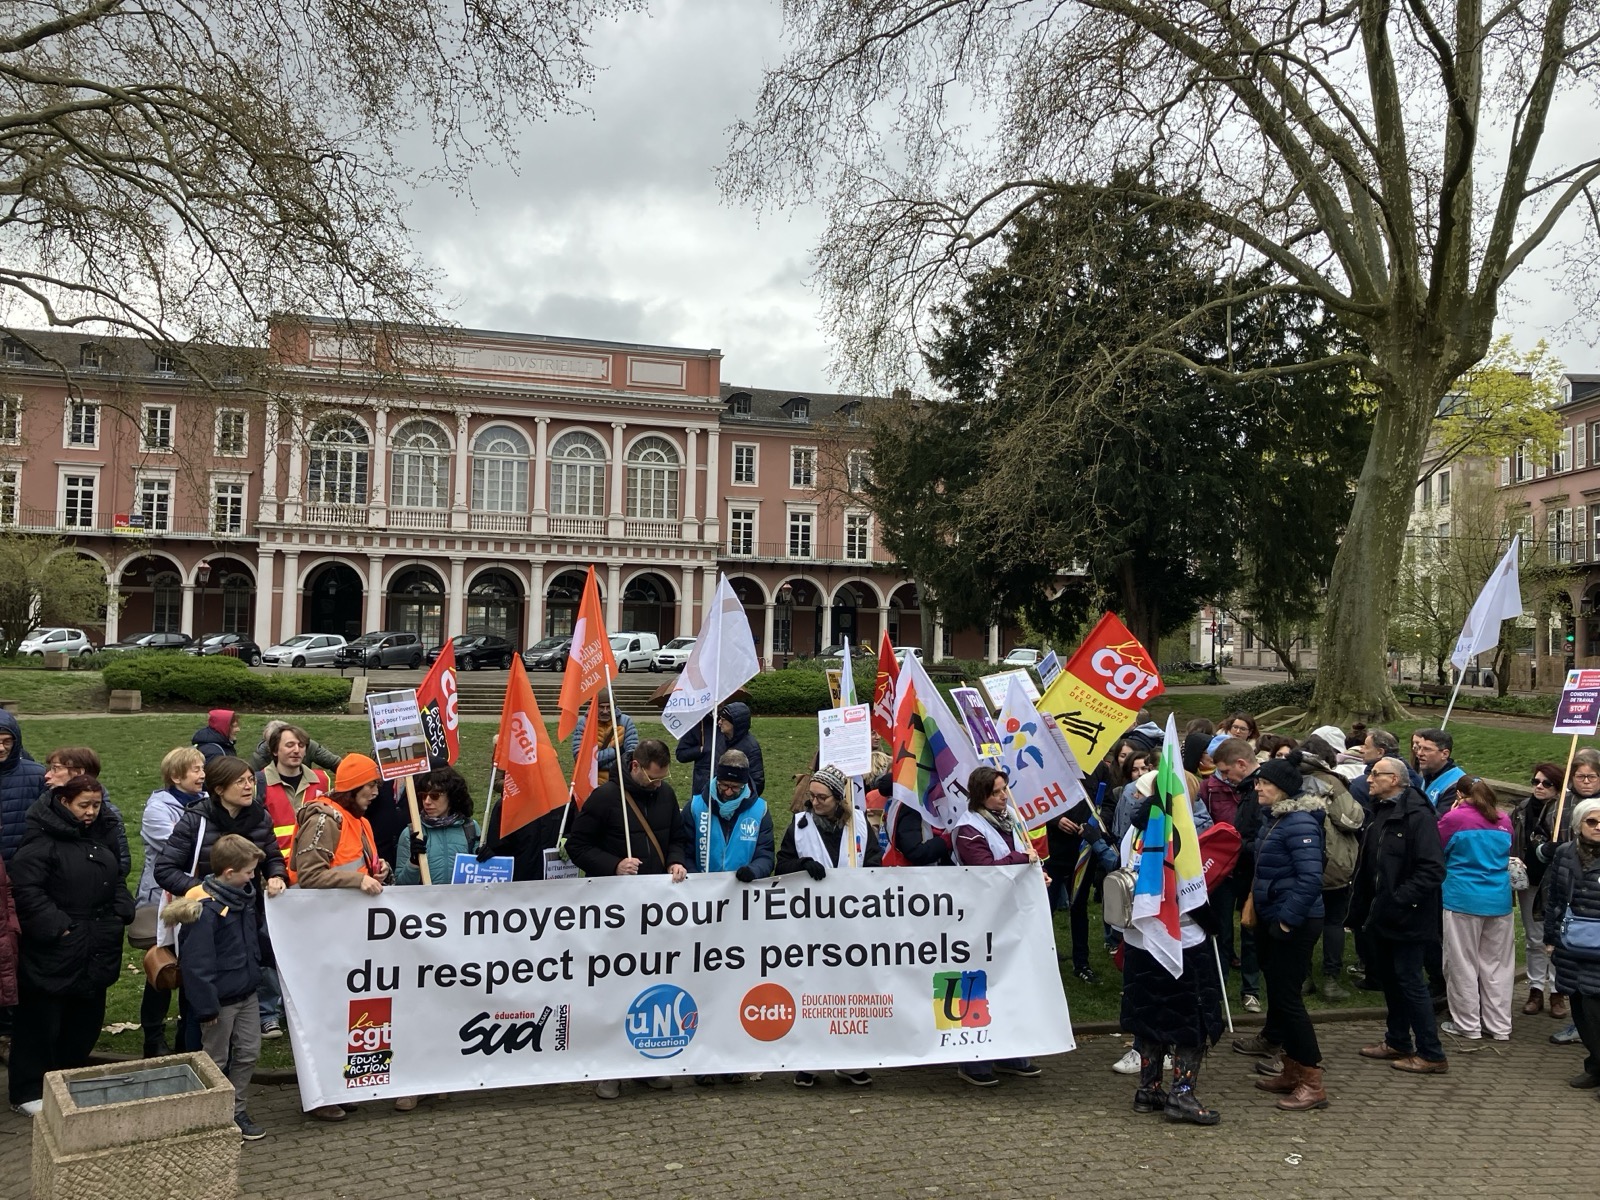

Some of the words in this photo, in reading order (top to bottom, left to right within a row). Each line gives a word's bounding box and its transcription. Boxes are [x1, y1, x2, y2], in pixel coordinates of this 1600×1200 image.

[1091, 648, 1159, 700] cgt
[1069, 691, 1083, 703] DES
[1085, 701, 1124, 724] CHEMINOTS
[1073, 685, 1129, 720] FEDERATION
[460, 862, 479, 875] ICI
[367, 907, 447, 941] Des
[463, 904, 626, 941] moyens
[640, 898, 730, 935] pour
[742, 881, 964, 922] l'Éducation,
[346, 958, 400, 994] du
[417, 948, 574, 995] respect
[587, 951, 681, 987] pour
[693, 941, 746, 973] les
[760, 932, 971, 978] personnels
[986, 931, 993, 963] !
[801, 993, 846, 1006] ÉDUCATION
[848, 994, 894, 1005] FORMATION
[350, 1012, 384, 1030] la
[494, 1010, 535, 1020] éducation
[802, 1007, 847, 1019] RECHERCHE
[849, 1007, 893, 1018] PUBLIQUES
[554, 1004, 568, 1051] Solidaires
[829, 1019, 869, 1035] ALSACE
[348, 1022, 392, 1051] cgt
[638, 1037, 685, 1048] éducation
[940, 1030, 992, 1047] F.S.U.
[347, 1074, 389, 1088] ALSACE
